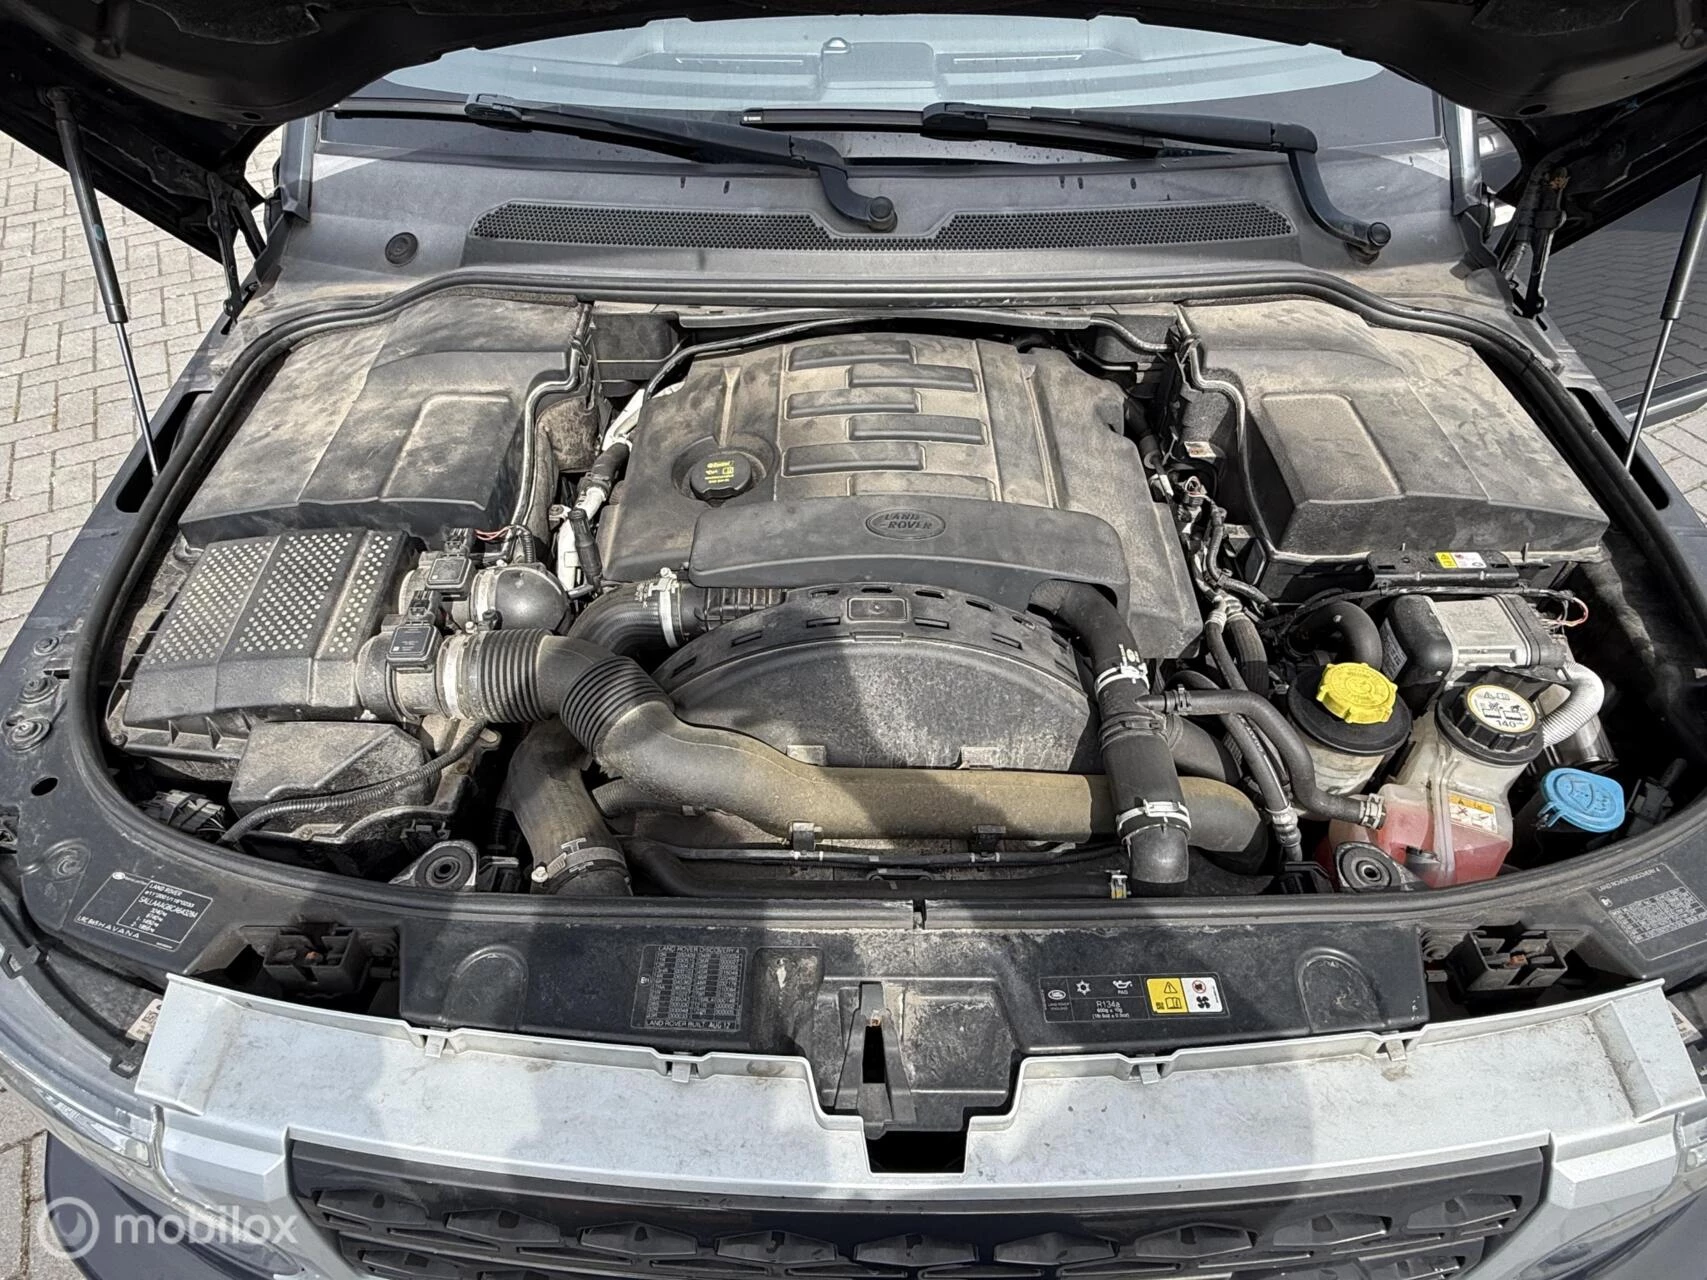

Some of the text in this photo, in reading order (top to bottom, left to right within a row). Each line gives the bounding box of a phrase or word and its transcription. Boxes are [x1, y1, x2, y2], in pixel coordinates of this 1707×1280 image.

[884, 513, 920, 521] LAND
[887, 521, 933, 530] ROVER
[1496, 720, 1516, 728] 140
[164, 888, 182, 896] ROVER
[98, 922, 140, 938] HAVANA
[1096, 1000, 1121, 1009] R134a
